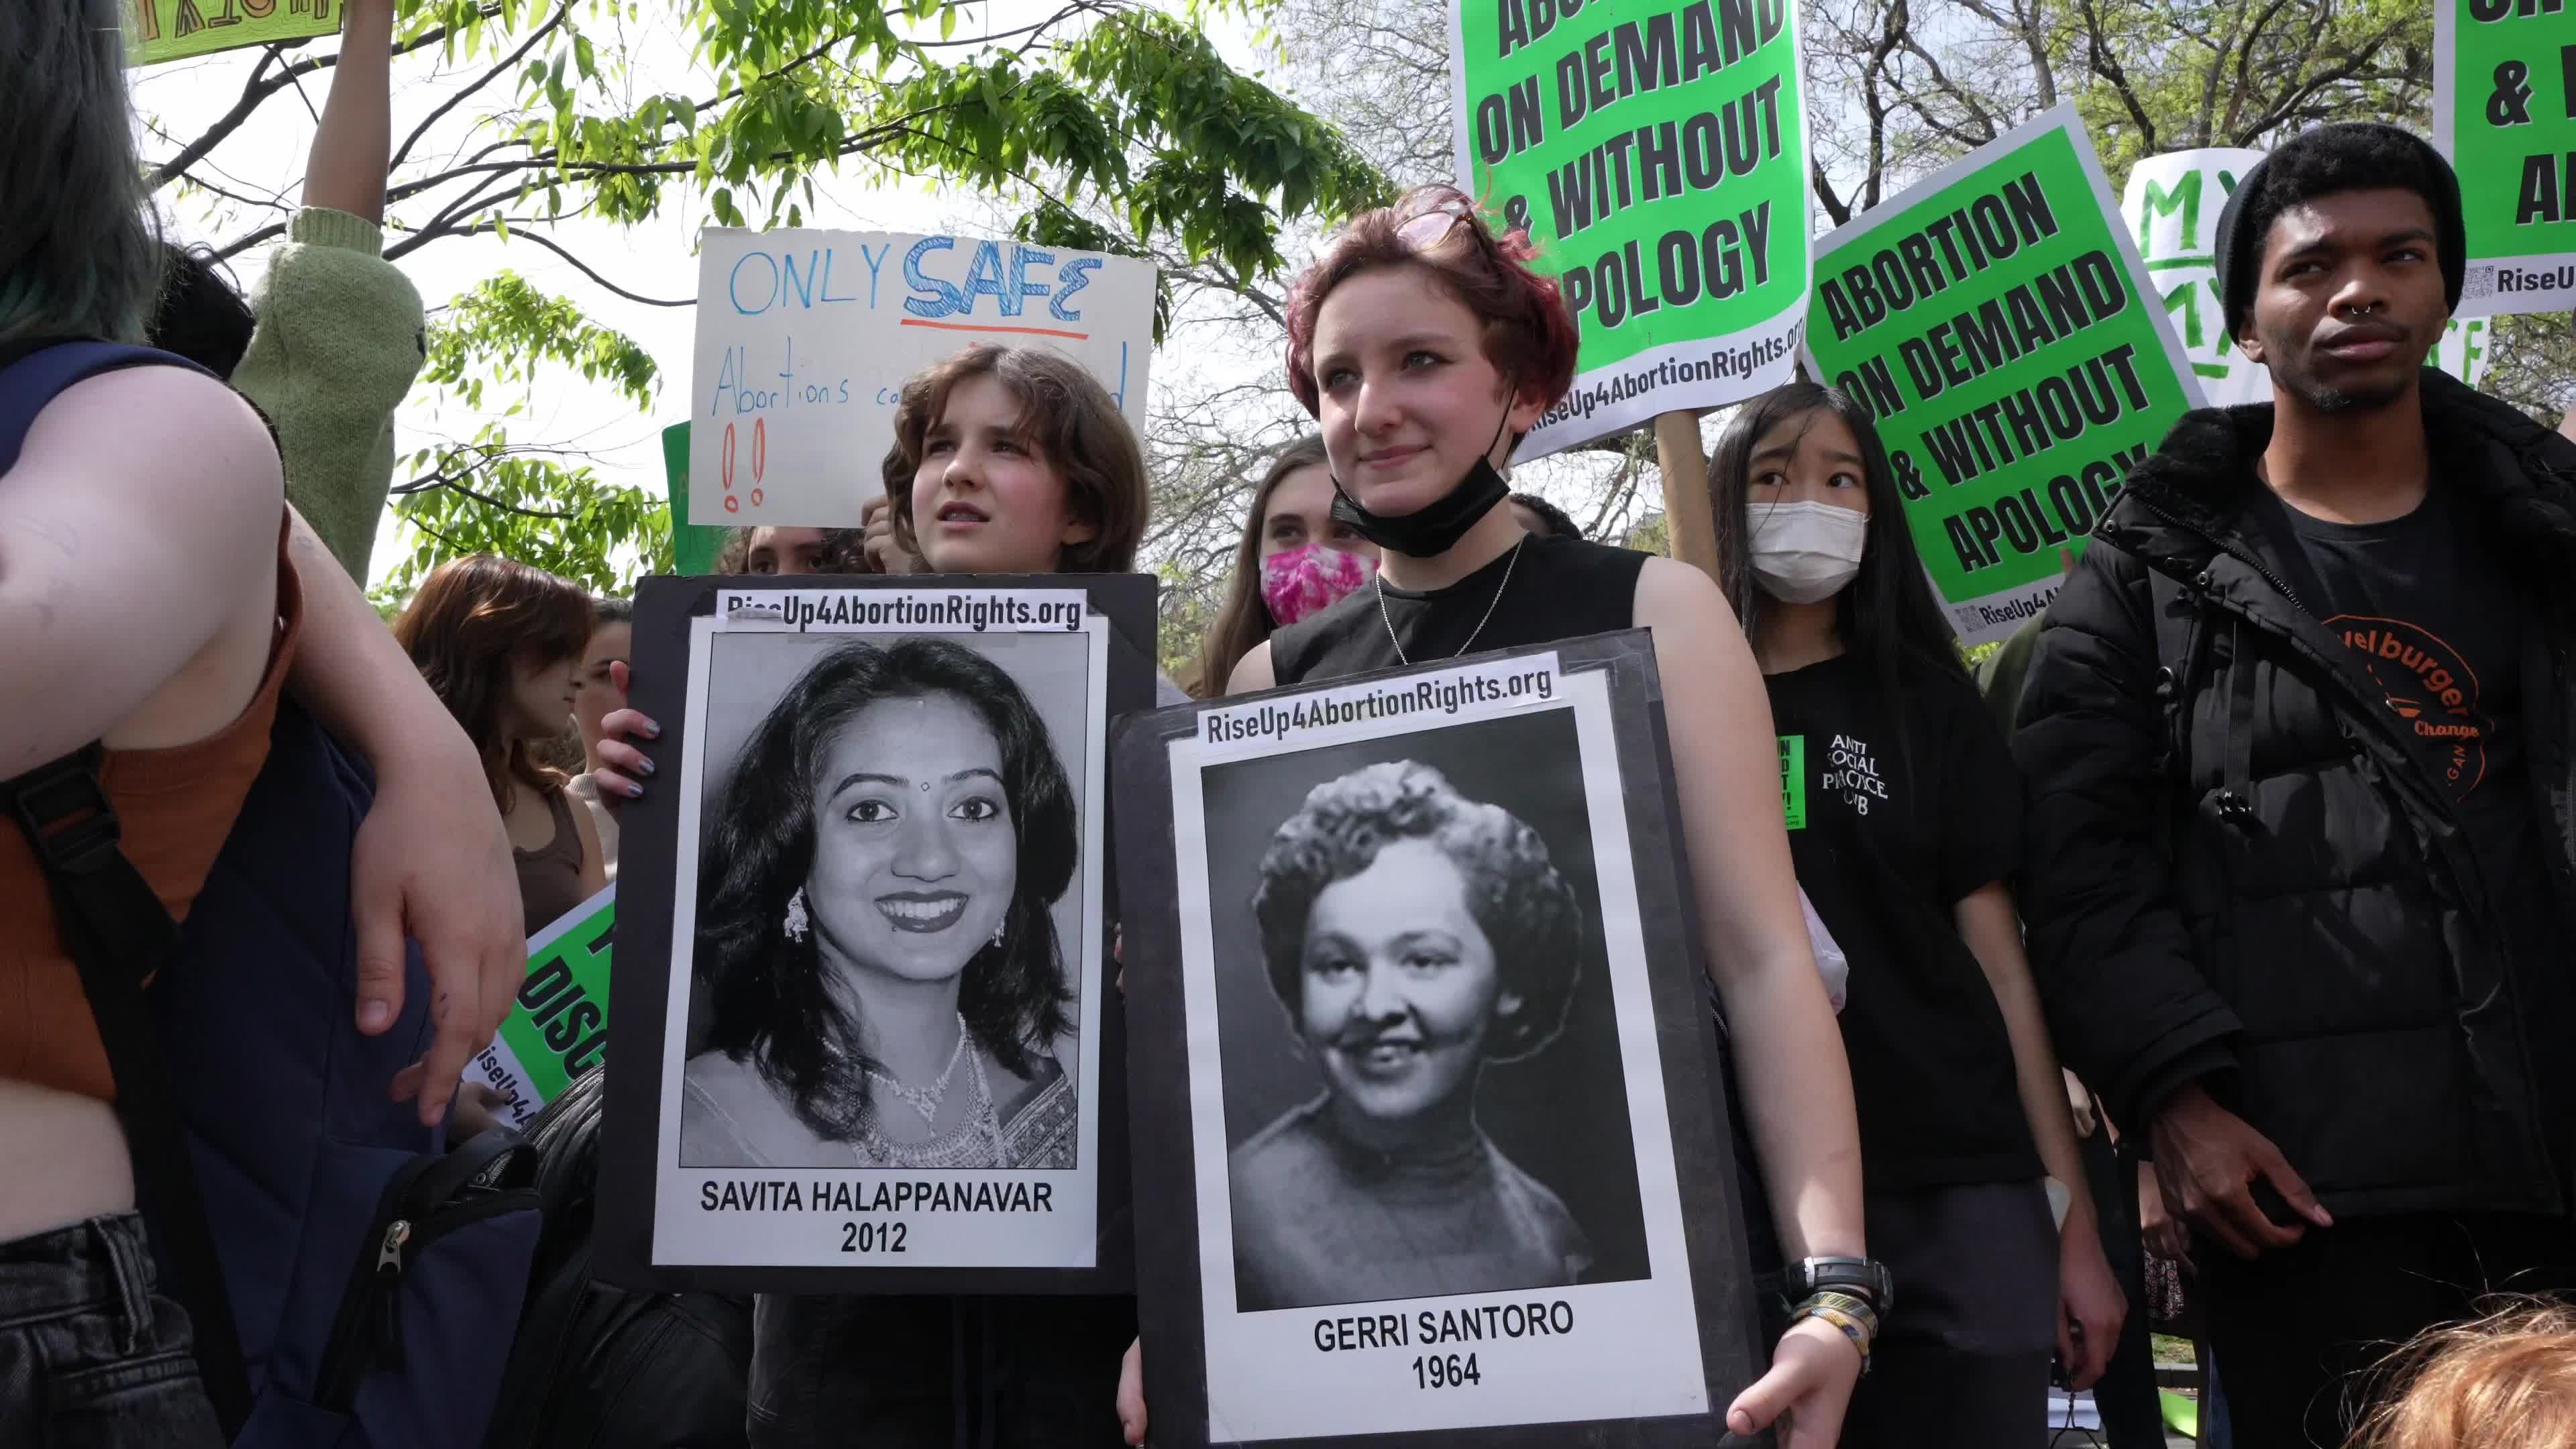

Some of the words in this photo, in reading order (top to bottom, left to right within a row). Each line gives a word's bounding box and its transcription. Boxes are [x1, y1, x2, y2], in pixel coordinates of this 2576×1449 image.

[1477, 75, 1544, 165] ON
[1556, 0, 1786, 131] DEMAND
[2486, 60, 2534, 126] &
[1504, 195, 1535, 250] &
[1546, 73, 1782, 241] WITHOUT
[730, 243, 891, 315] ONLY
[1562, 200, 1771, 332] POLOGY
[1819, 172, 2059, 341] ABORTION
[1898, 250, 2128, 400] DEMAND
[712, 336, 849, 417] Abortions
[1890, 449, 1931, 502] &
[1920, 343, 2150, 487] WITHOUT
[1207, 669, 1552, 743] RiseUp4AbortionRights.org
[1826, 749, 1879, 777] SOCIAL
[1830, 735, 1867, 755] ANTI
[2447, 744, 2467, 781] GAN
[516, 955, 608, 1080] DISC
[701, 1181, 803, 1212] SAVITA
[812, 1182, 1053, 1212] HALAPPANAVAR
[841, 1222, 908, 1252] 2012
[1313, 1313, 1409, 1352] GERRI
[1417, 1300, 1574, 1344] SANTORO
[1412, 1352, 1481, 1389] 1964
